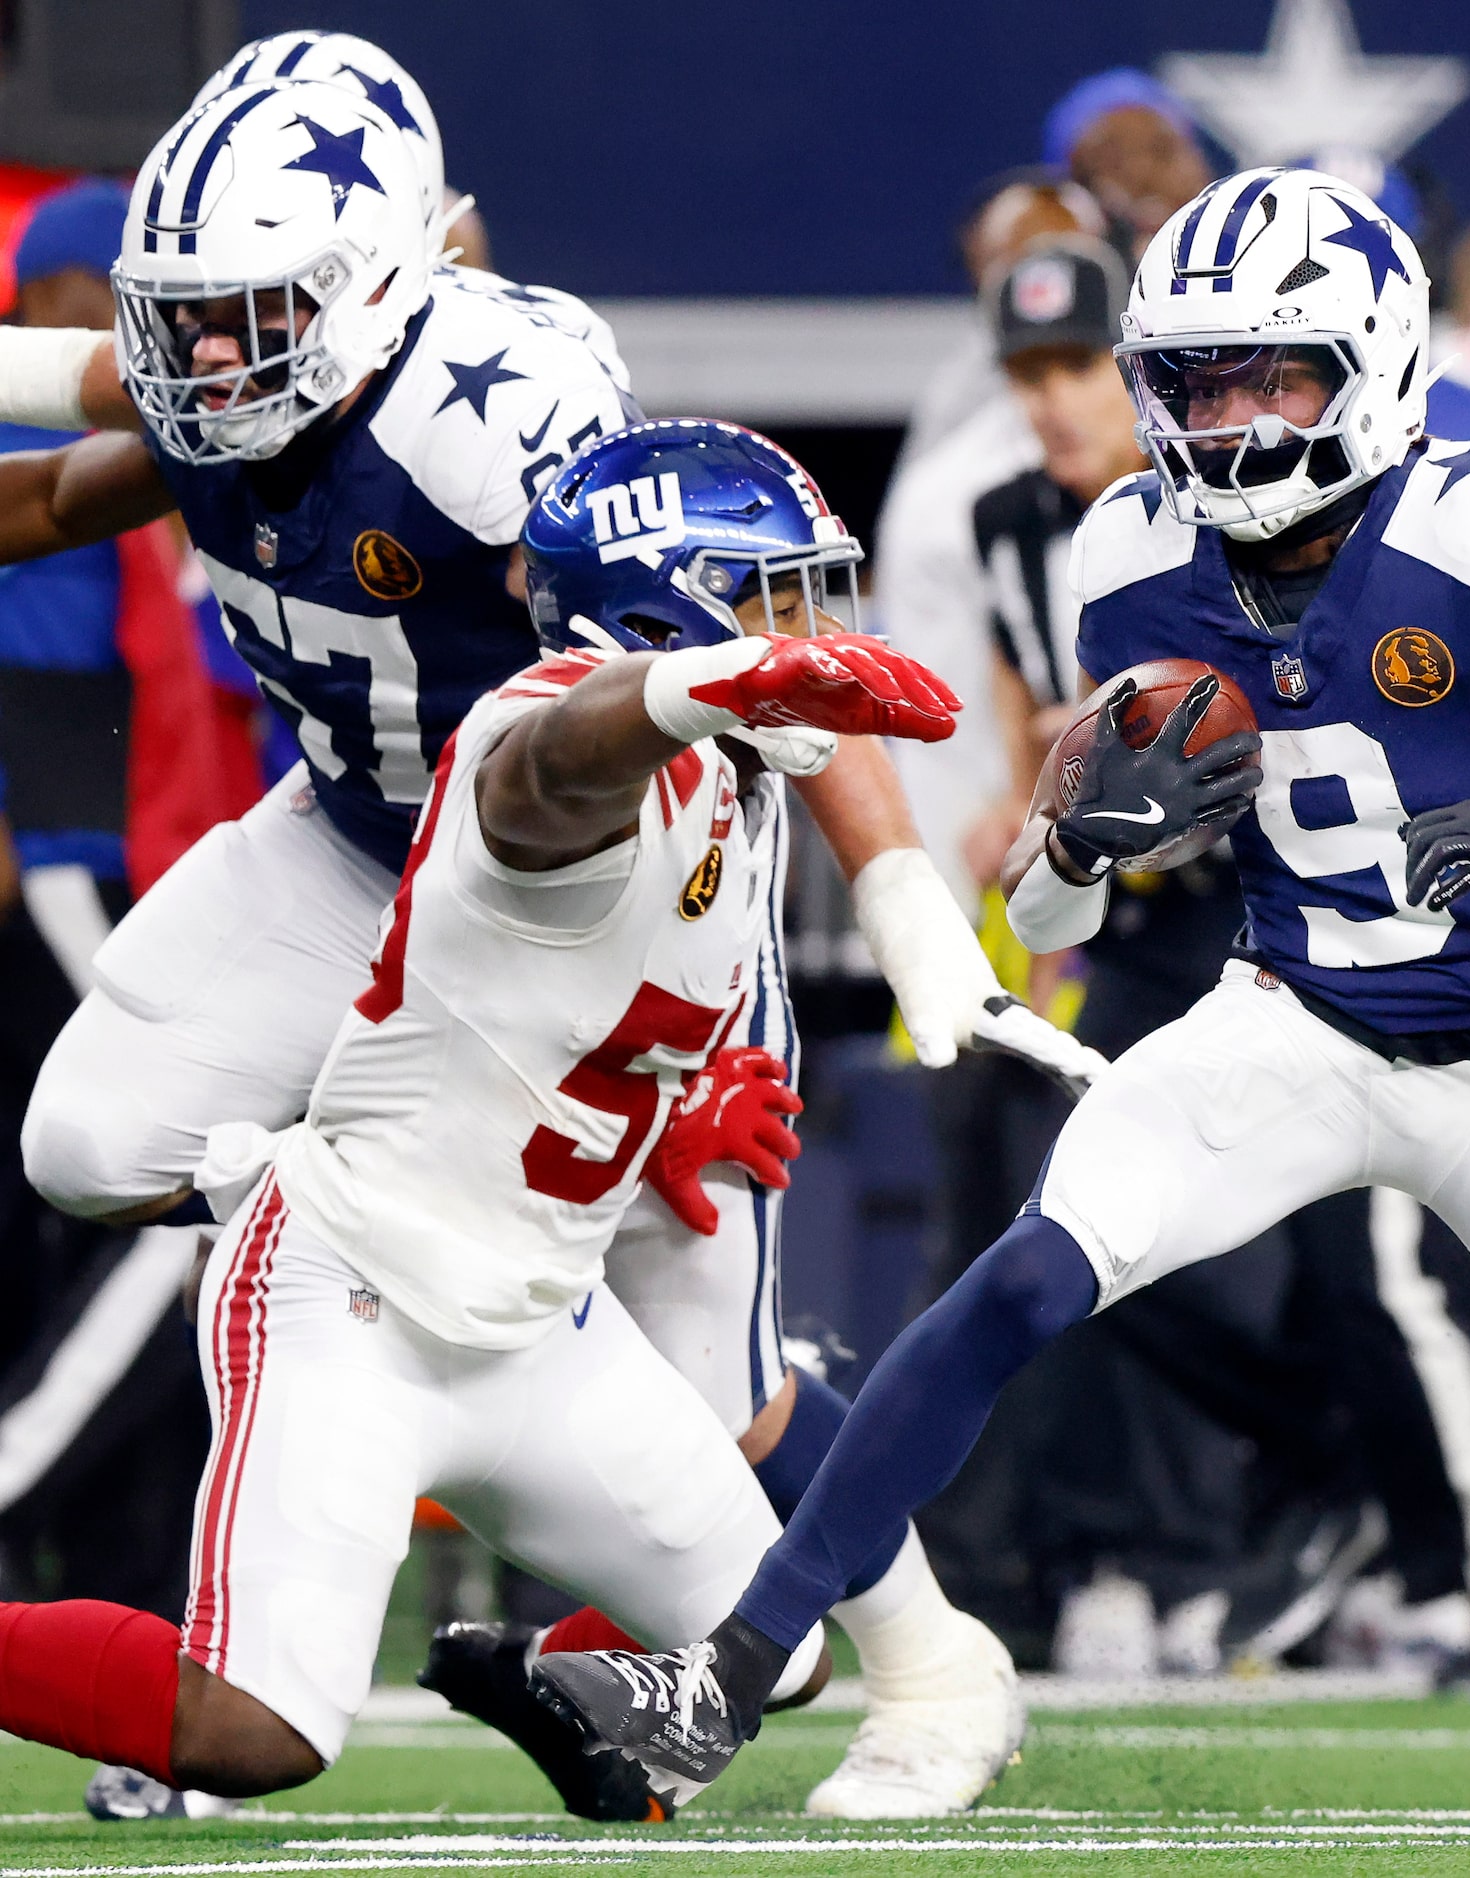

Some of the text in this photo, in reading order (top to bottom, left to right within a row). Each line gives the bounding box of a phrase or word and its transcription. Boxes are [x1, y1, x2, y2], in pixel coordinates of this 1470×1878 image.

[1279, 675, 1304, 693] NFL
[1255, 721, 1457, 969] 9
[353, 1300, 376, 1317] NFL
